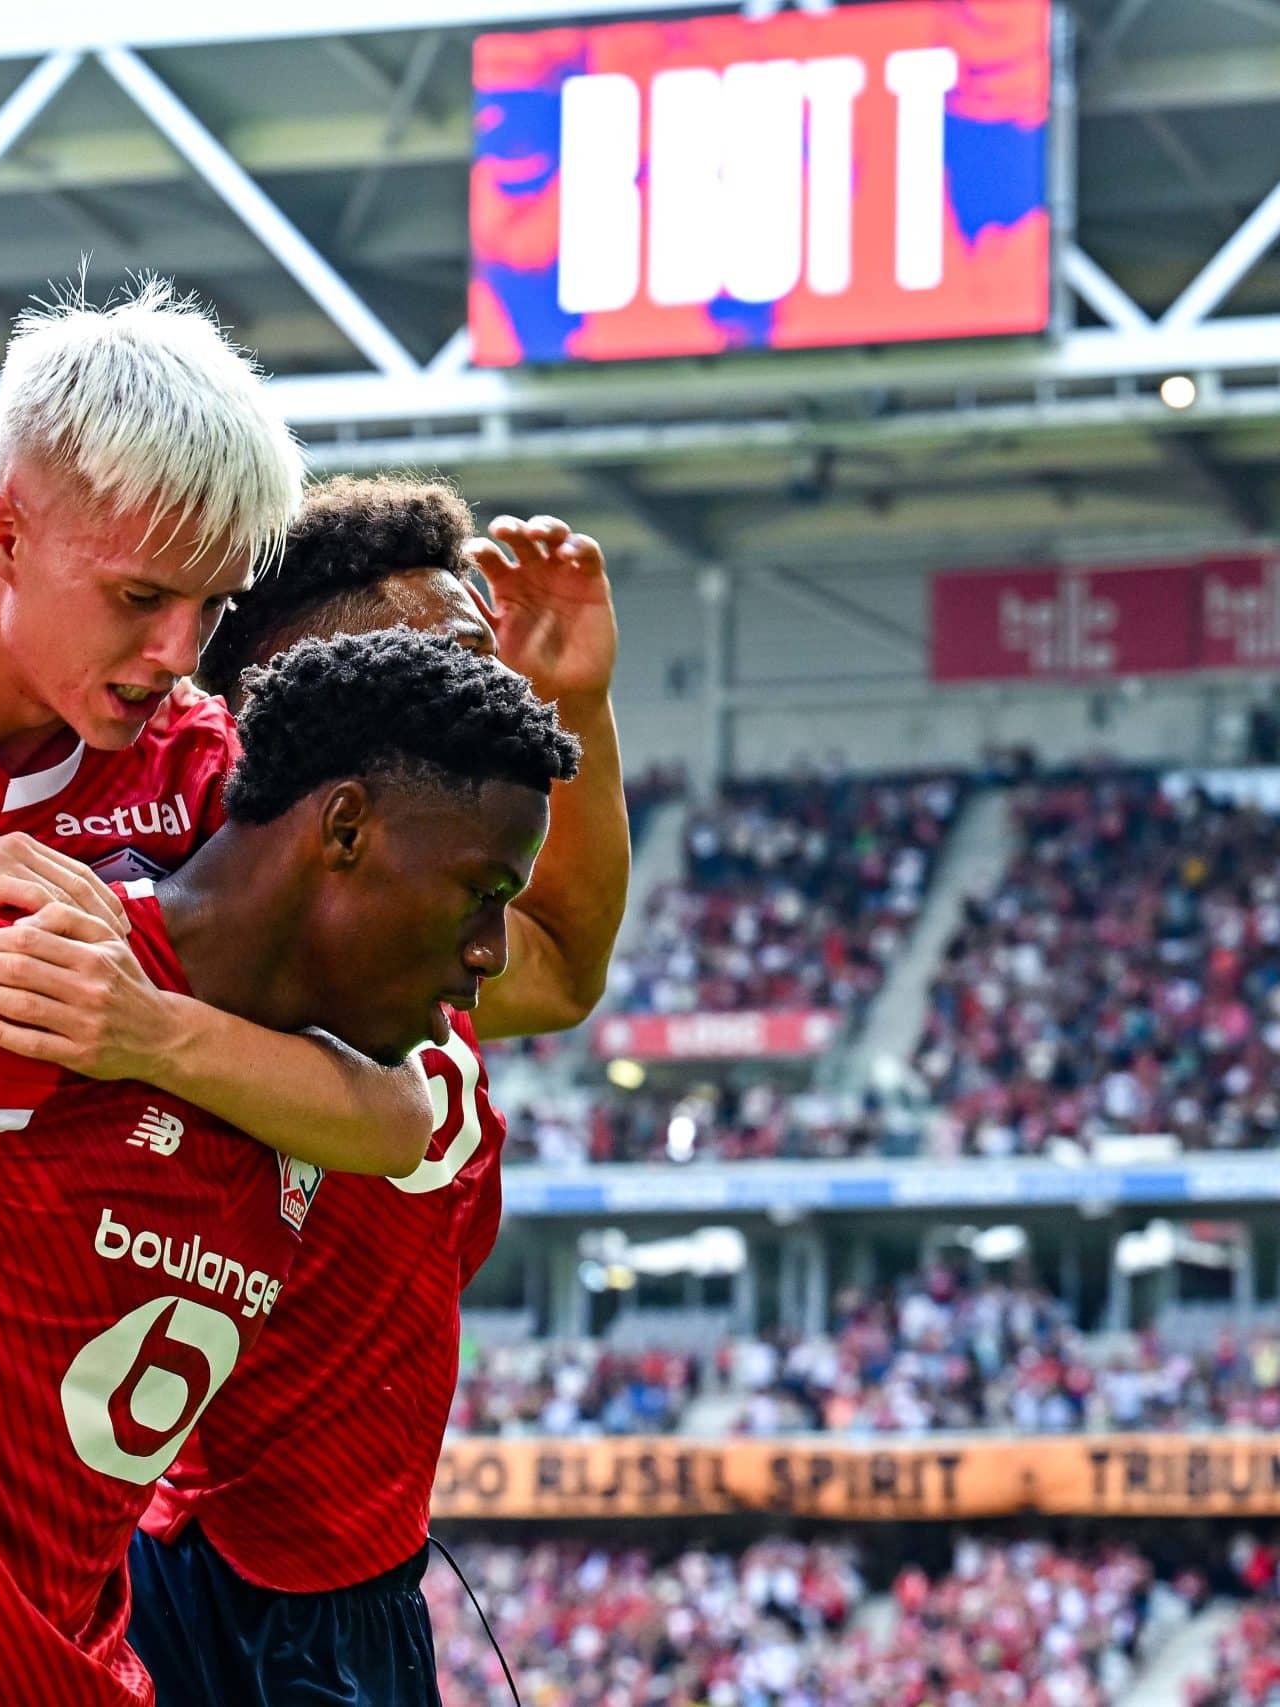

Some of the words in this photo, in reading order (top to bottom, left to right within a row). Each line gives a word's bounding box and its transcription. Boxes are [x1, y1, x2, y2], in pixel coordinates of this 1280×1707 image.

[55, 794, 191, 837] actual
[284, 1194, 305, 1222] LOSC
[94, 1208, 284, 1319] boulange
[771, 1452, 961, 1503] SPIRIT
